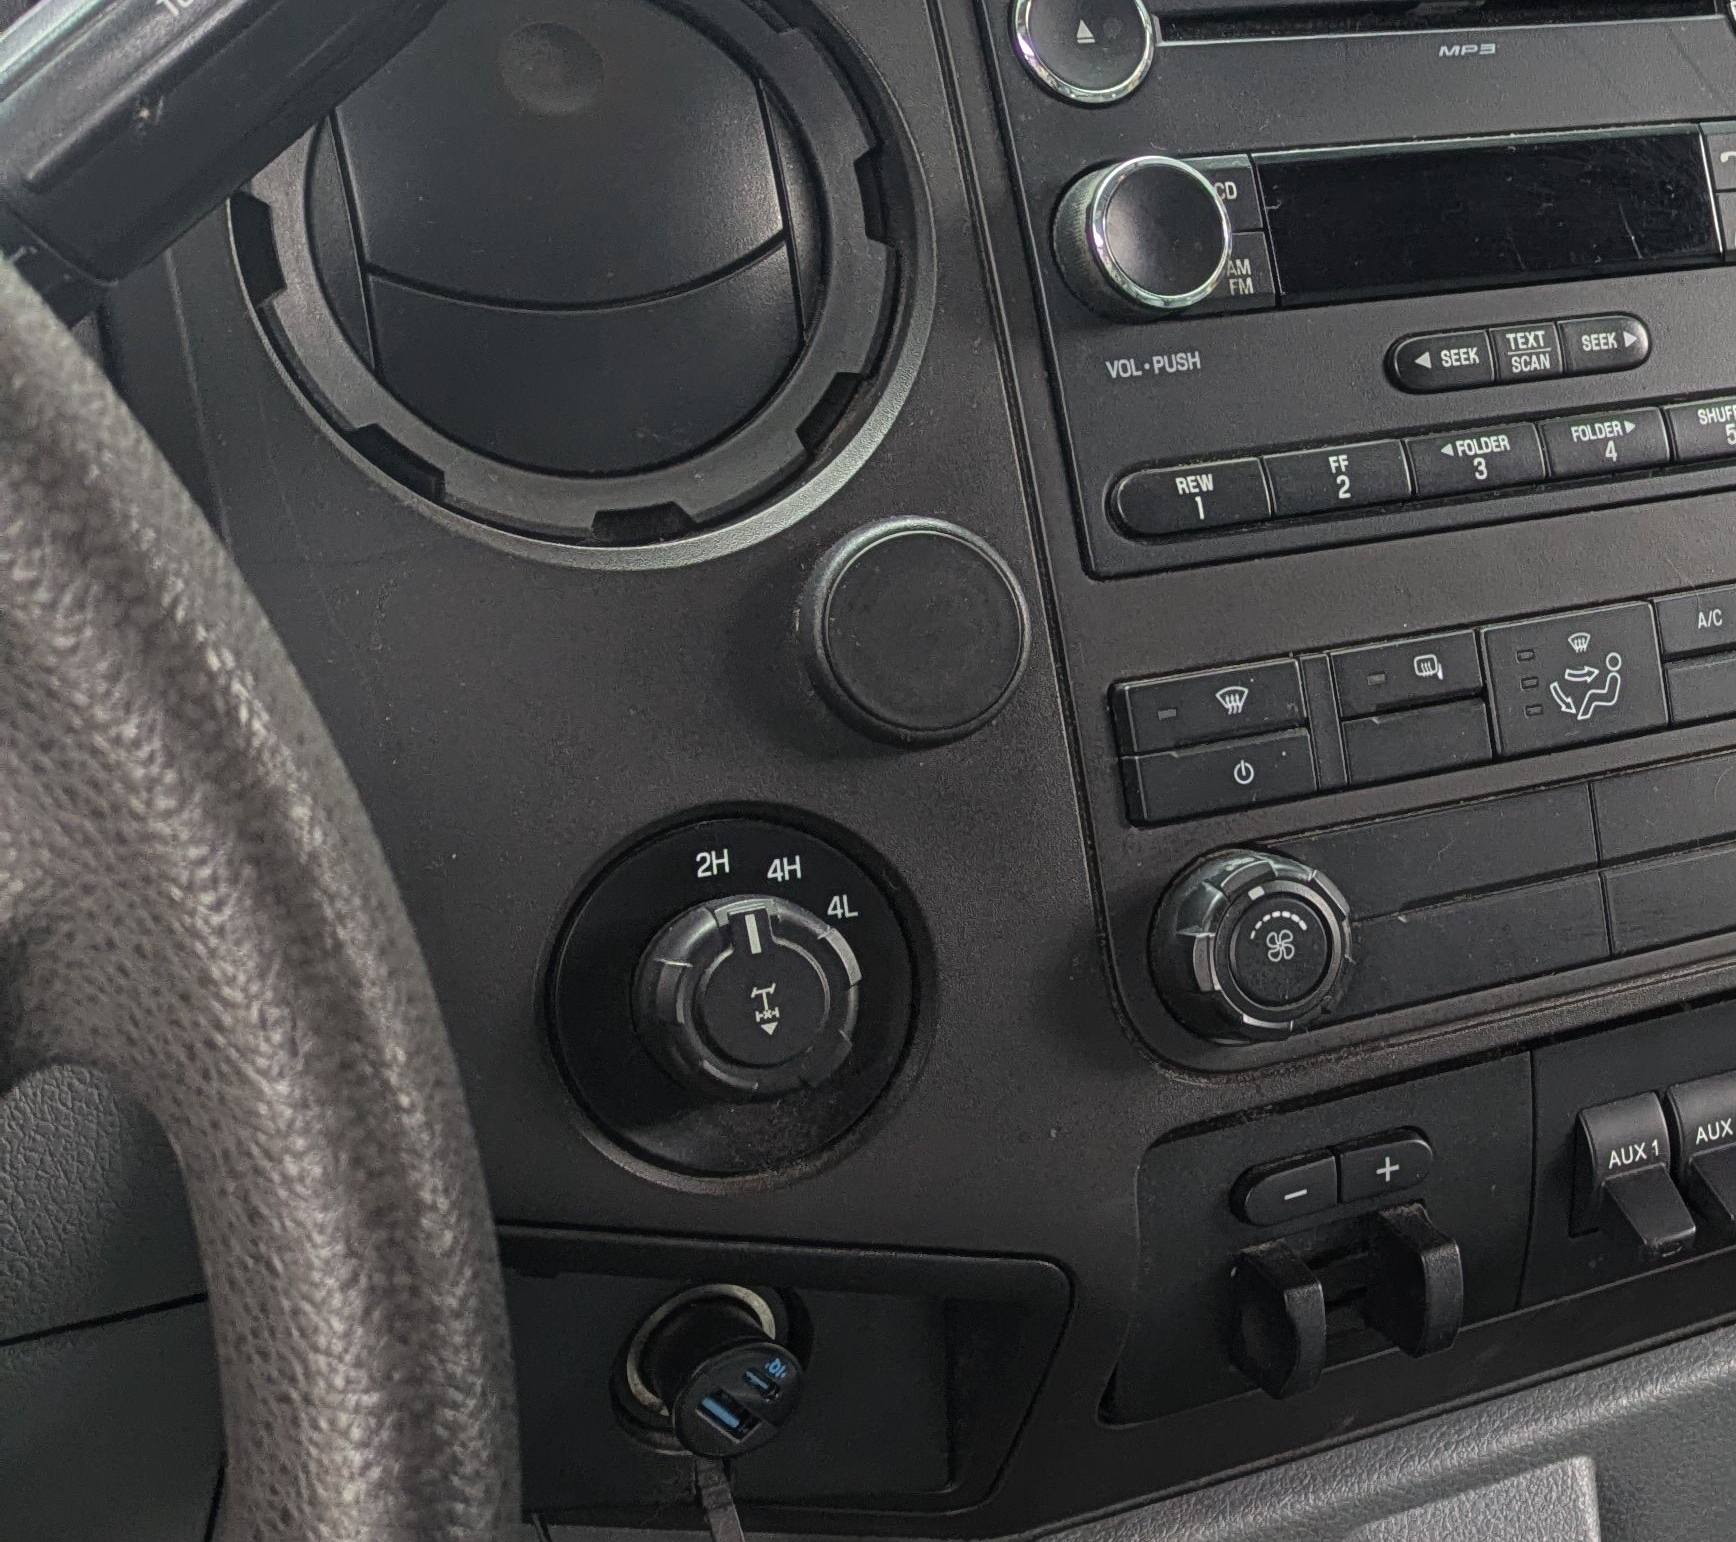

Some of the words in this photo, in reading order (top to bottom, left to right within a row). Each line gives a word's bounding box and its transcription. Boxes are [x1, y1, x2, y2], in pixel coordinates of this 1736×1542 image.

[1438, 43, 1496, 57] MP3
[1213, 181, 1238, 201] CD
[1226, 258, 1252, 277] AM
[1228, 277, 1255, 296] FM
[1506, 330, 1546, 350] TEXT
[1581, 332, 1618, 352] SEEK
[1440, 347, 1480, 368] SEEK
[1511, 353, 1551, 373] SCAN
[1571, 420, 1623, 442] FOLDER
[1455, 435, 1511, 457] FOLDER
[1604, 439, 1618, 462] 4
[1327, 455, 1350, 474] FF
[1473, 458, 1489, 481] 3
[1175, 473, 1214, 495] REW
[1335, 475, 1352, 500] 2
[1194, 496, 1206, 521] 1
[1697, 608, 1723, 630] A/C
[695, 848, 730, 879] 2H
[767, 855, 802, 883] 4H
[826, 894, 859, 920] 4L
[1695, 1118, 1734, 1145] AUX
[1608, 1141, 1648, 1169] AUX
[1651, 1139, 1660, 1157] 1
